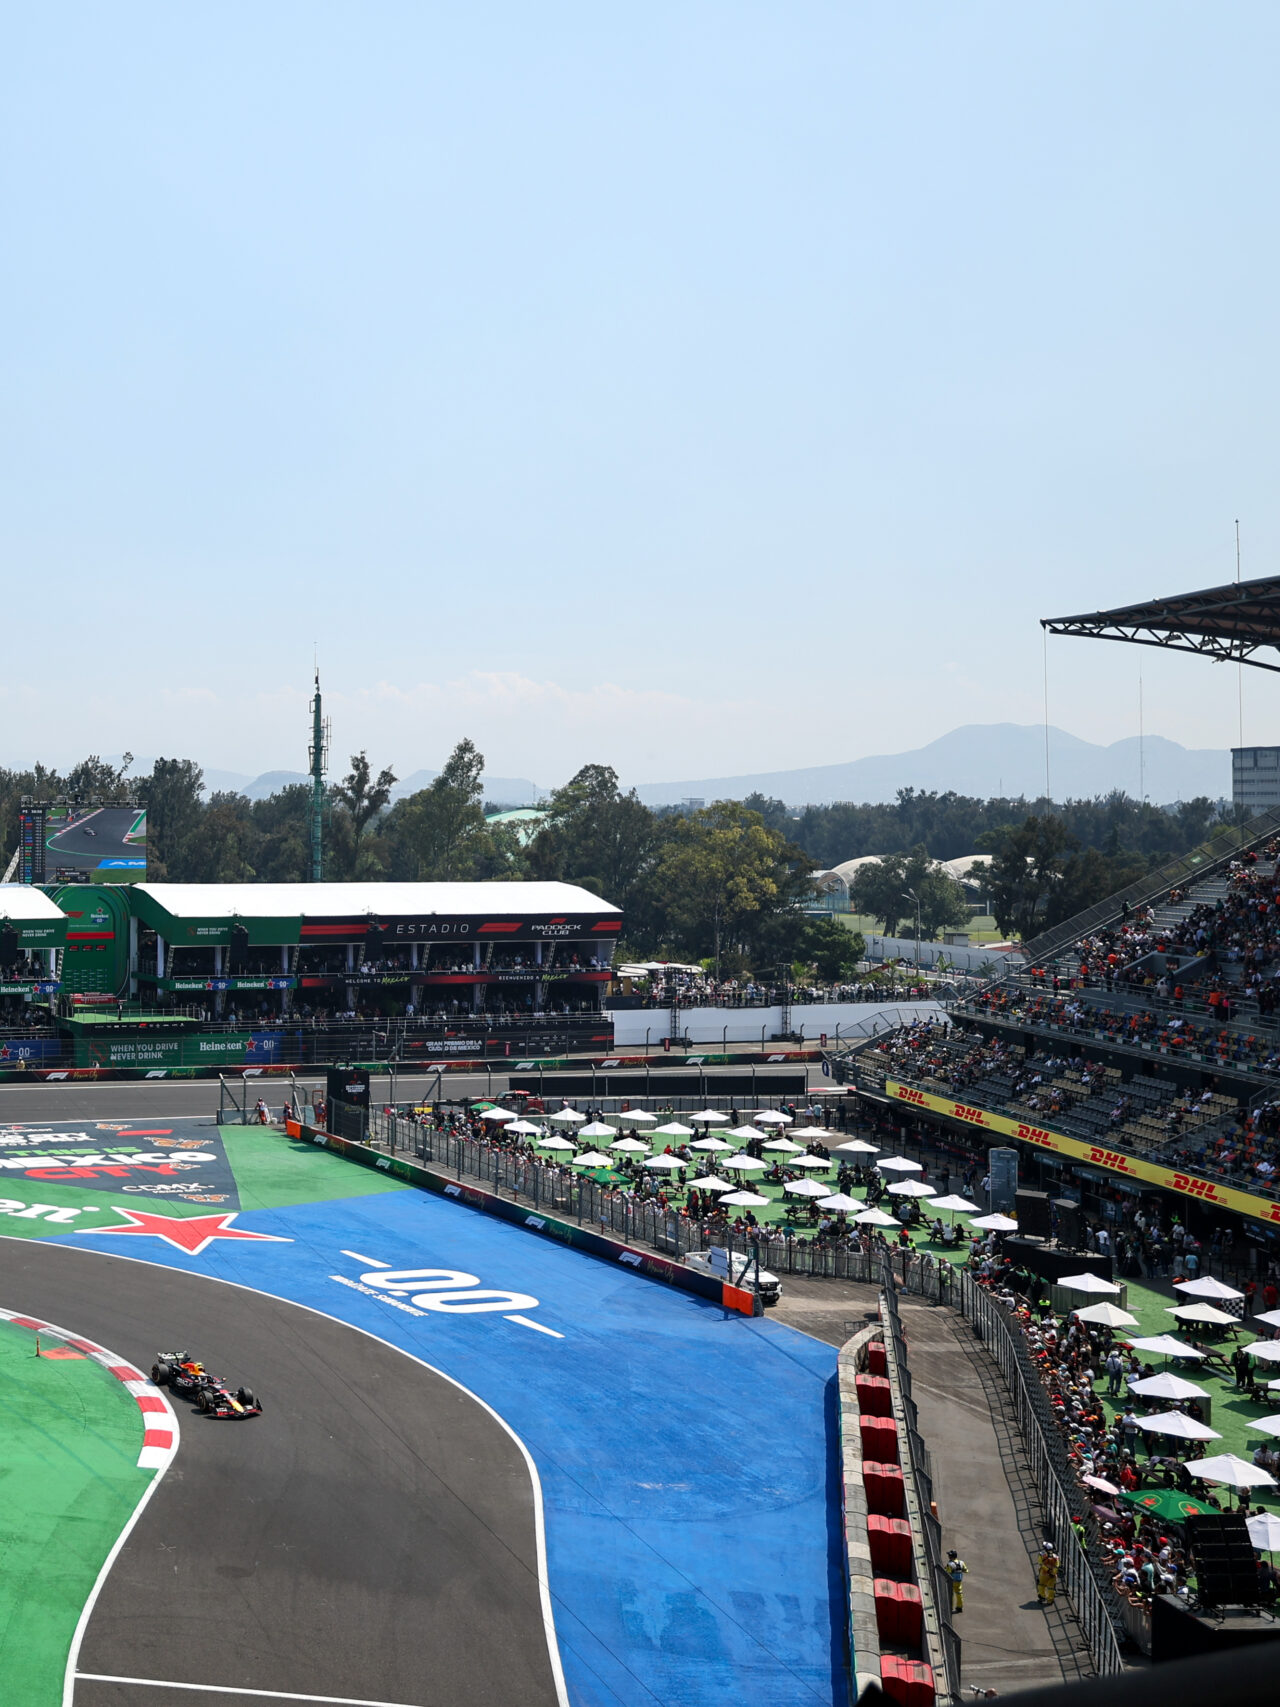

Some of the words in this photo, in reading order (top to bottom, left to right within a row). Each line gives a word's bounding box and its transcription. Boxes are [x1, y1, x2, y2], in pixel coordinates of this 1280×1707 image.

[396, 923, 470, 934] ESTADIO
[381, 976, 410, 984] Mexico
[0, 985, 30, 993] Heineken
[110, 1044, 135, 1053] WHEN
[136, 1043, 153, 1051] YOU
[155, 1042, 179, 1050] DRIVE
[199, 1041, 242, 1051] Heineken
[110, 1053, 136, 1061] NEVER
[138, 1051, 163, 1059] DRINK
[45, 1072, 69, 1080] F1
[145, 1070, 167, 1078] F1
[242, 1068, 263, 1076] F1
[898, 1086, 926, 1105] DHL
[954, 1104, 985, 1125] DHL
[1018, 1124, 1051, 1147] DHL
[3, 1148, 100, 1156] THIS
[103, 1146, 142, 1154] IS
[1090, 1147, 1129, 1172] DHL
[24, 1162, 180, 1180] CITY
[444, 1184, 462, 1197] F1
[1173, 1173, 1218, 1201] DHL
[524, 1215, 546, 1230] F1
[618, 1251, 643, 1267] F1
[176, 1377, 194, 1387] ORACLE
